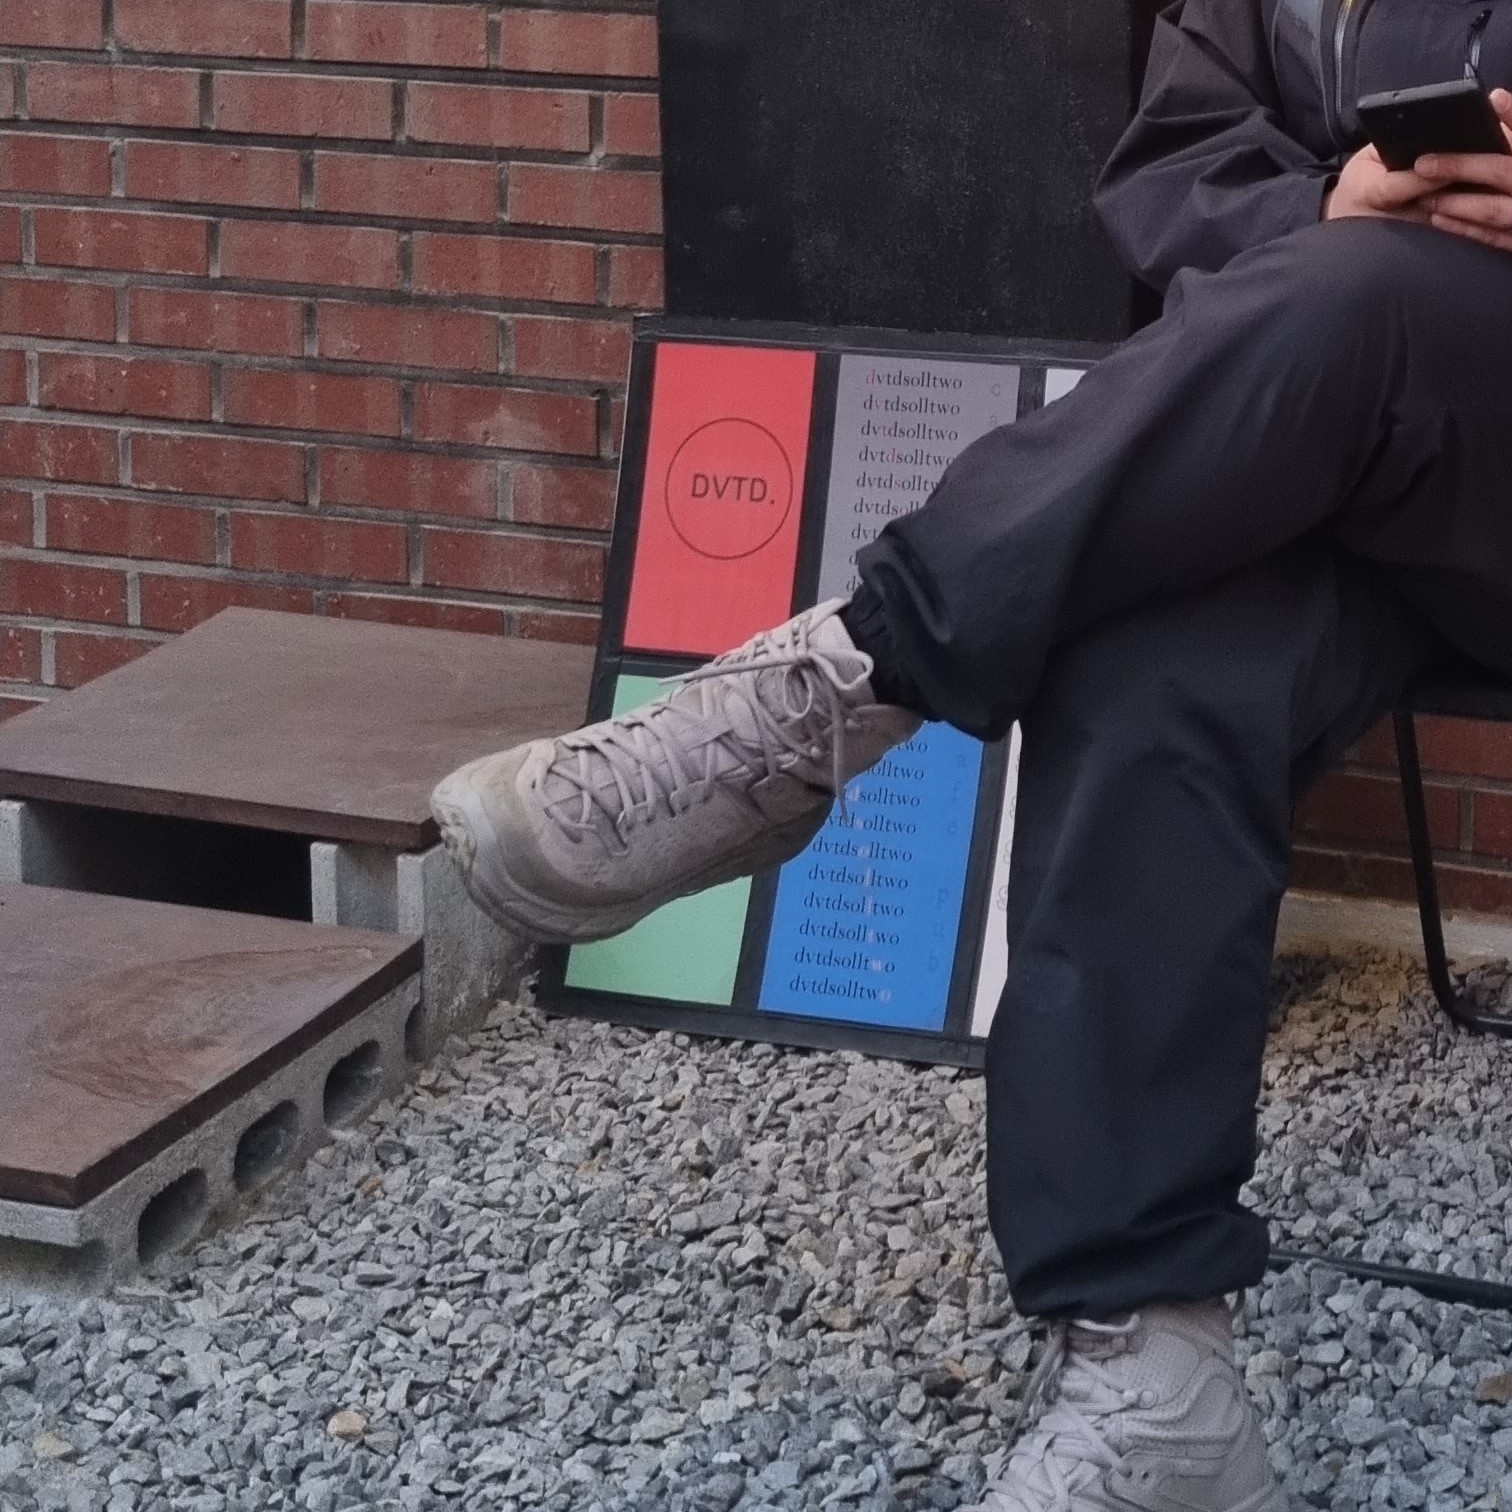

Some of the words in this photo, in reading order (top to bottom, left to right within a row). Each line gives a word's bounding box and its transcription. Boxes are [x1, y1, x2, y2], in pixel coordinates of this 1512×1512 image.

[865, 368, 963, 390] dvtdsolltwo
[862, 393, 961, 416] dvtdsolltwo
[860, 419, 959, 442] dvtdsolltwo
[691, 472, 776, 505] DVTD.
